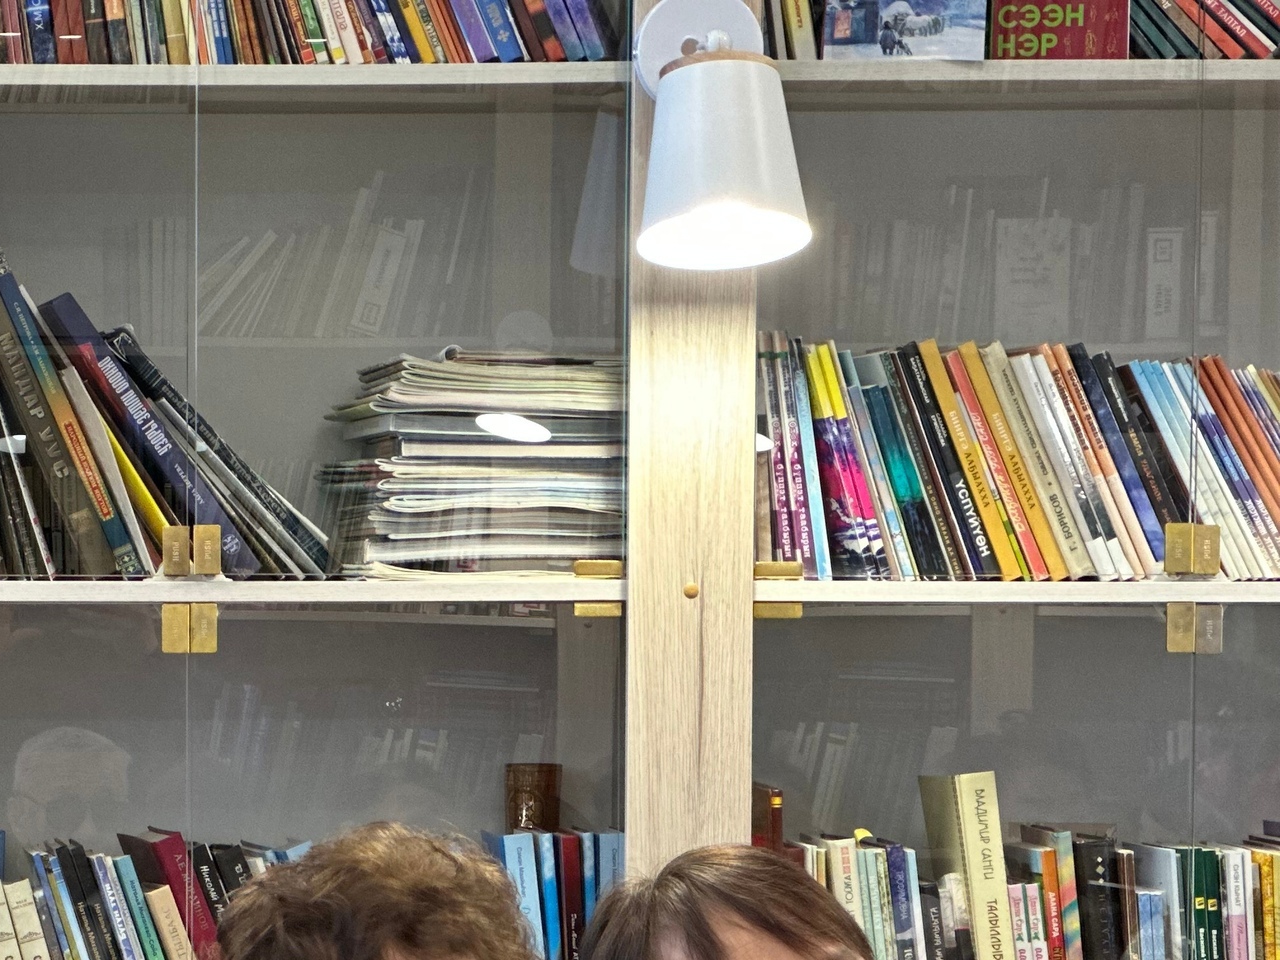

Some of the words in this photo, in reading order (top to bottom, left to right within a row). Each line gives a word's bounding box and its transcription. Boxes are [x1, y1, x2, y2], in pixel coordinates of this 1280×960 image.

[996, 2, 1086, 30] СЭЭН
[1216, 7, 1247, 37] ТАПТАЛ
[996, 33, 1058, 58] НЭР
[37, 425, 70, 479] УУС
[140, 418, 173, 456] УЗОРЫ
[797, 506, 811, 557] таабырын
[953, 478, 992, 557] ҮСПҮЙҮӨН
[1048, 493, 1073, 539] БОРИСОВ
[779, 507, 792, 557] таабырын
[1067, 540, 1078, 551] Г.
[972, 788, 990, 844] ВЛАДИМИР
[980, 847, 994, 879] САНГИ
[76, 901, 92, 931] Наталья
[93, 902, 109, 933] Наталья
[1198, 928, 1206, 957] Василий
[1210, 929, 1218, 959] Василий
